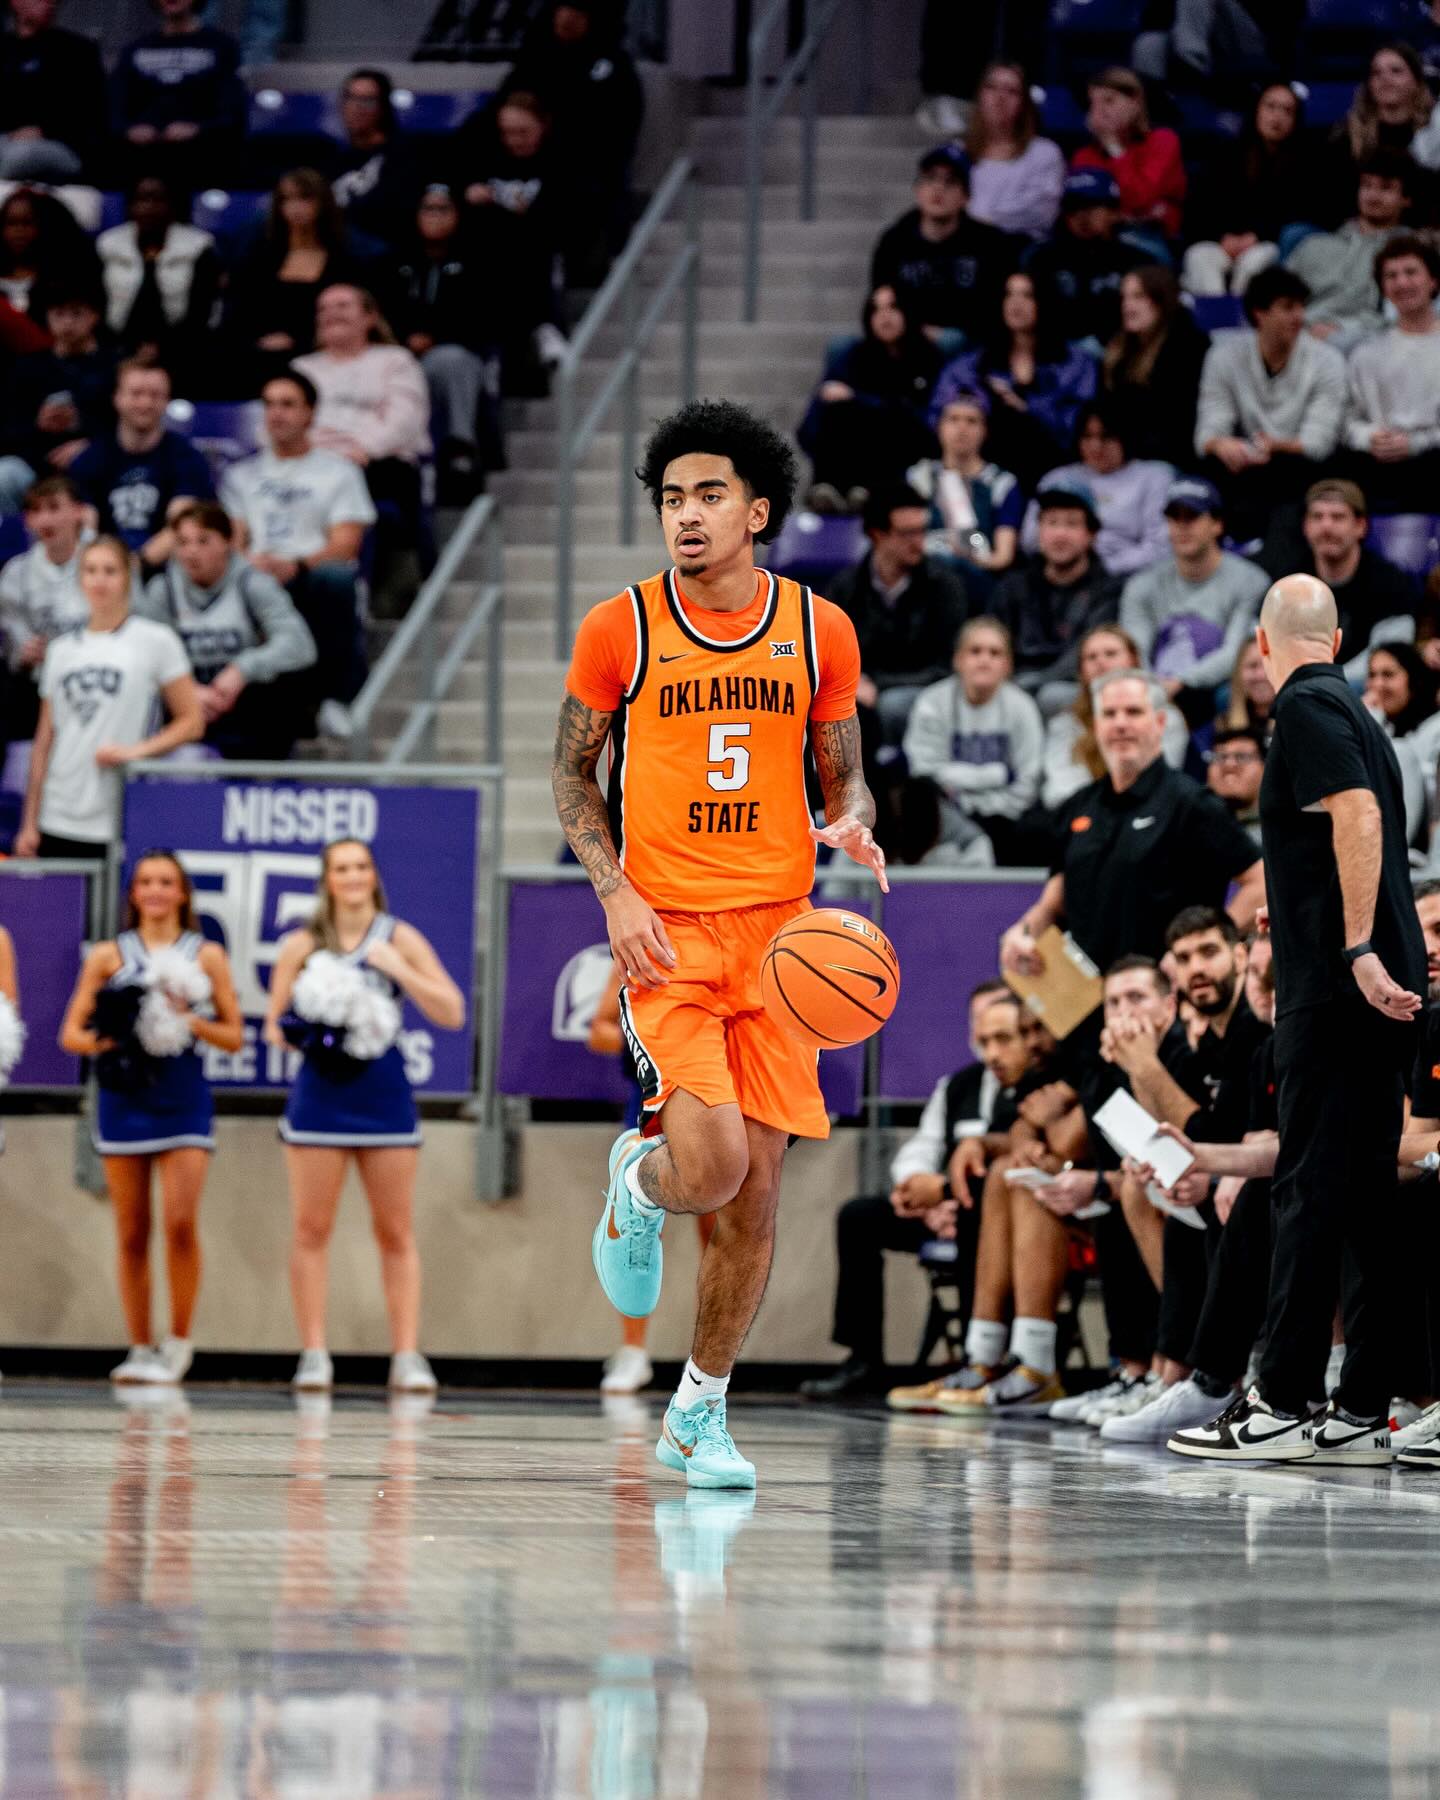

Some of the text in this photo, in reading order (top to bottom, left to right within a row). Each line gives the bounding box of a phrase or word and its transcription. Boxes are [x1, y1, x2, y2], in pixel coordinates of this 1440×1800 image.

[659, 676, 795, 718] OKLAHOMA
[706, 722, 751, 791] 5
[222, 786, 379, 844] MISSED
[688, 801, 760, 833] STATE
